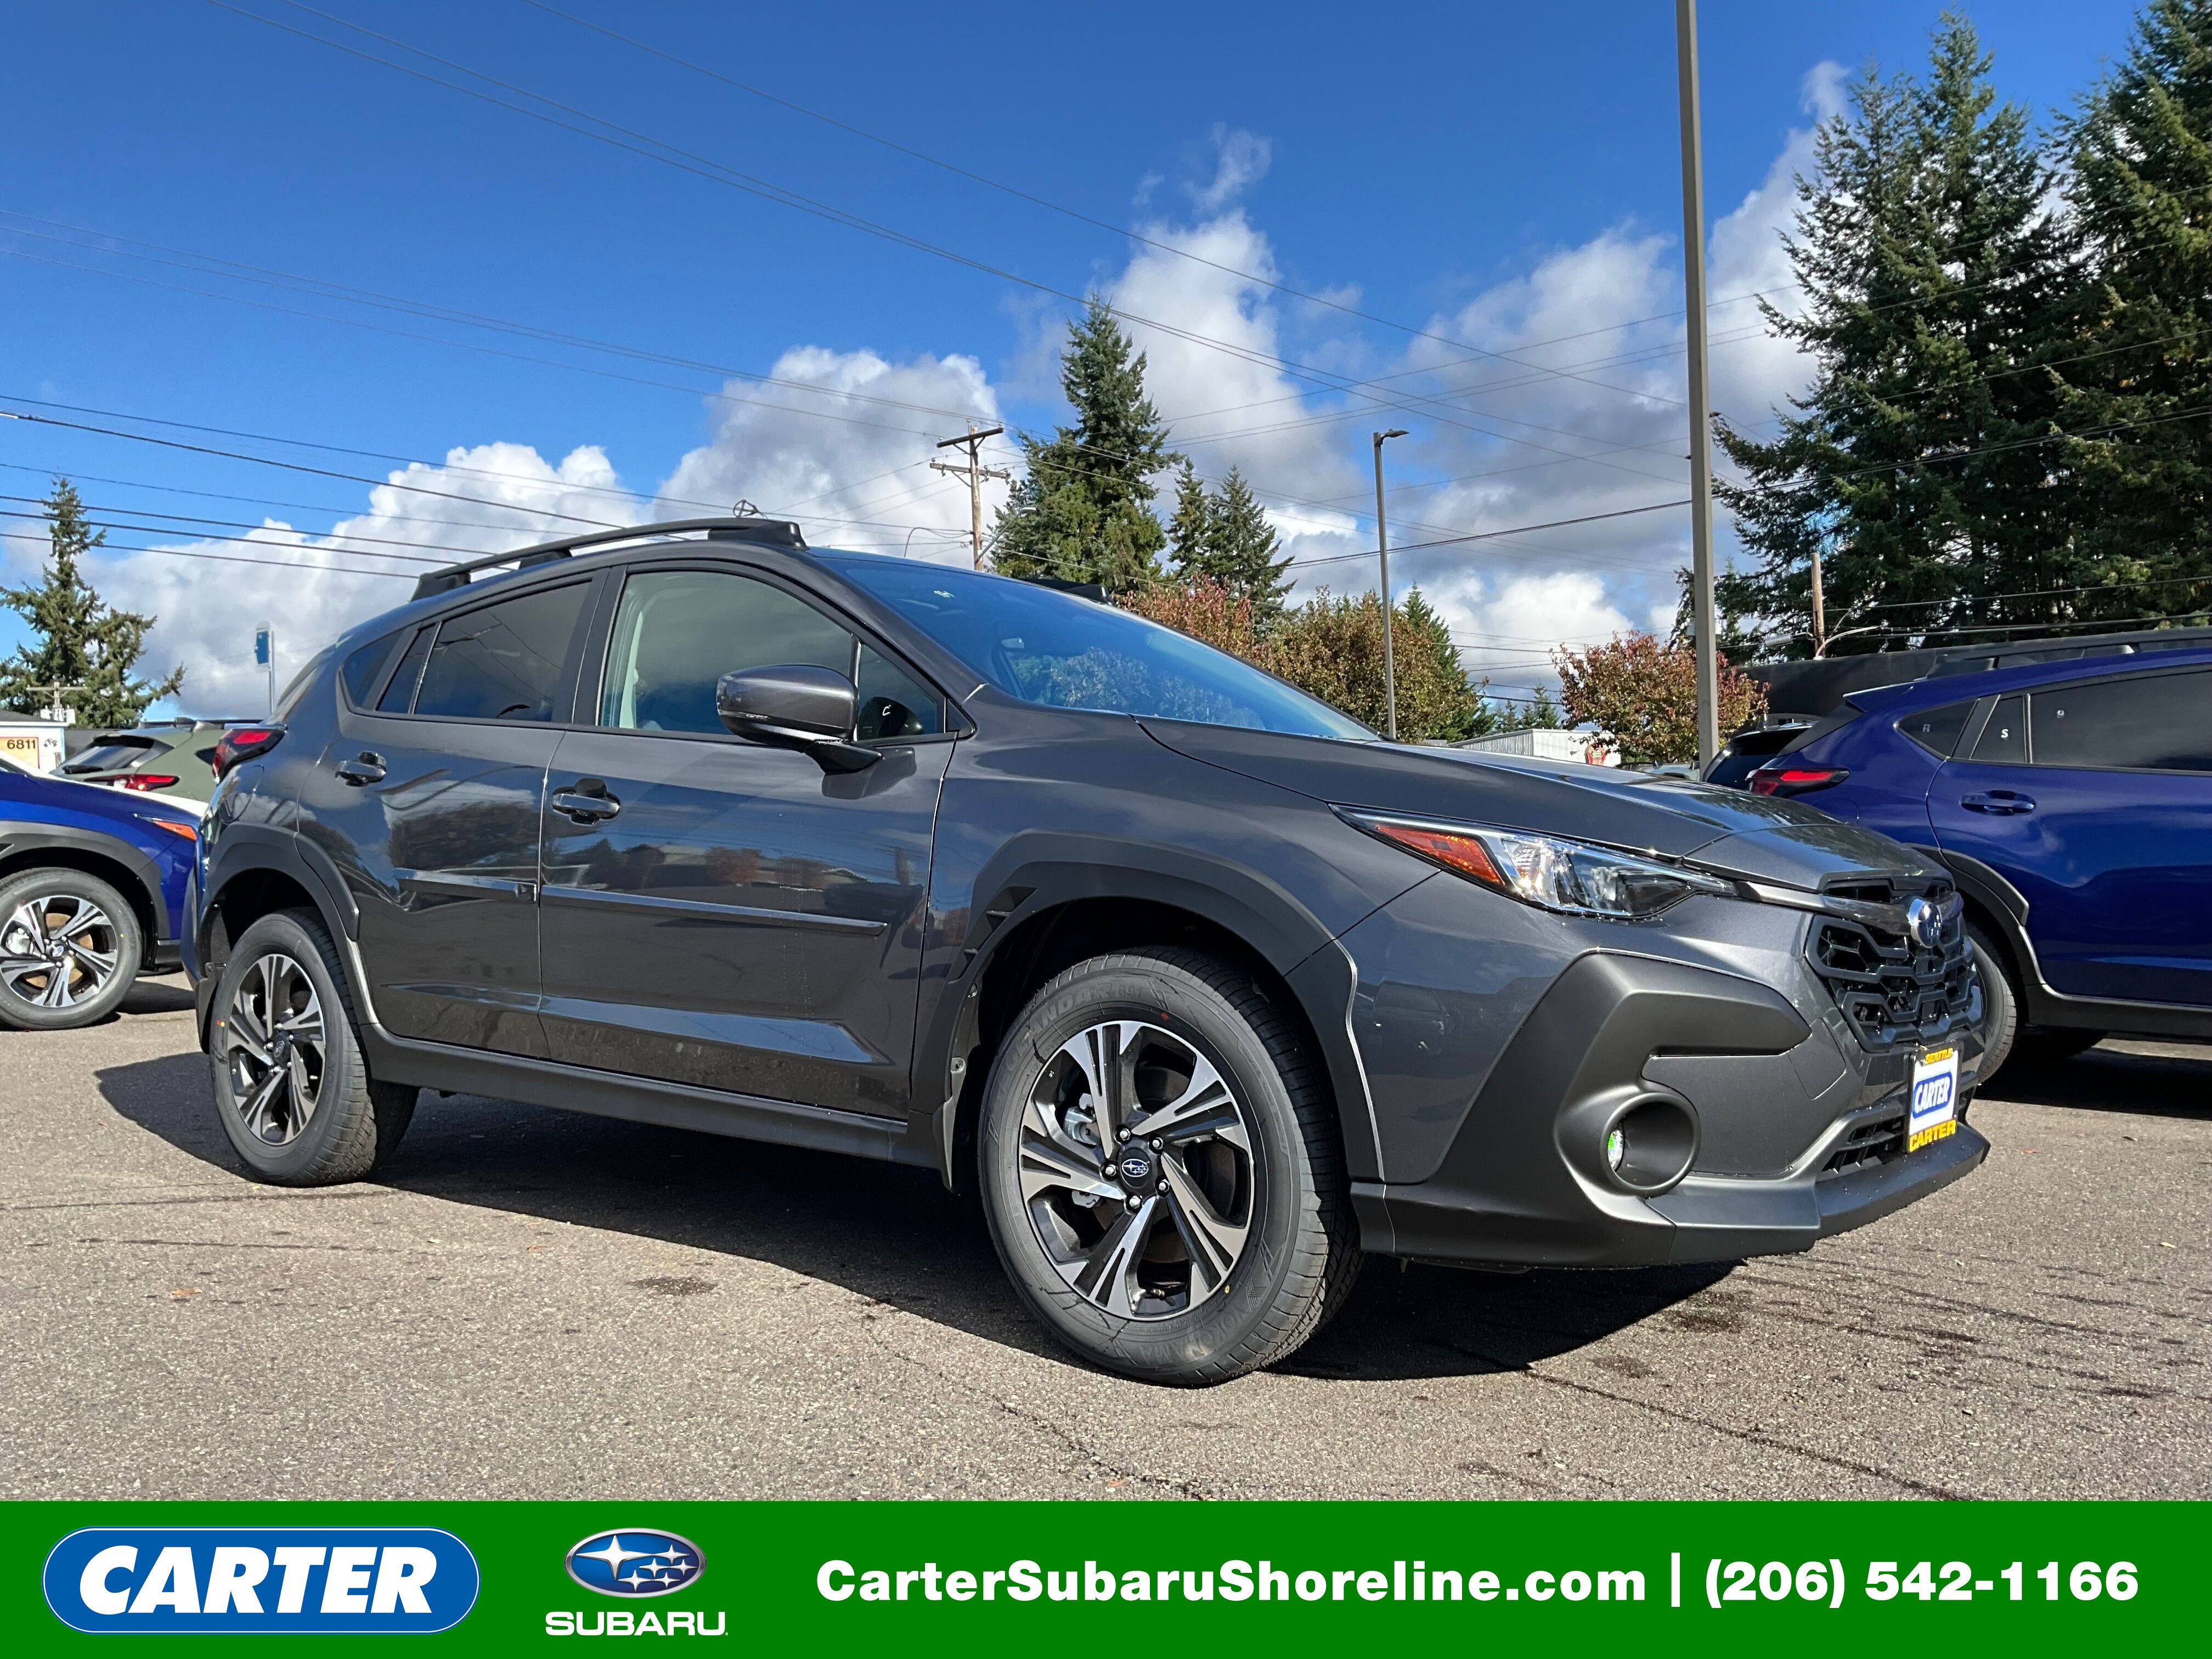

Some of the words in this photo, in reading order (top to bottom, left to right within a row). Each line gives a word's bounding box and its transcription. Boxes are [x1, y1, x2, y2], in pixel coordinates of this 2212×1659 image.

[7, 739, 36, 750] 6811
[1925, 1048, 1954, 1064] SEATTLE
[1914, 1076, 1951, 1114] CARTER
[1909, 1119, 1957, 1152] CARTER
